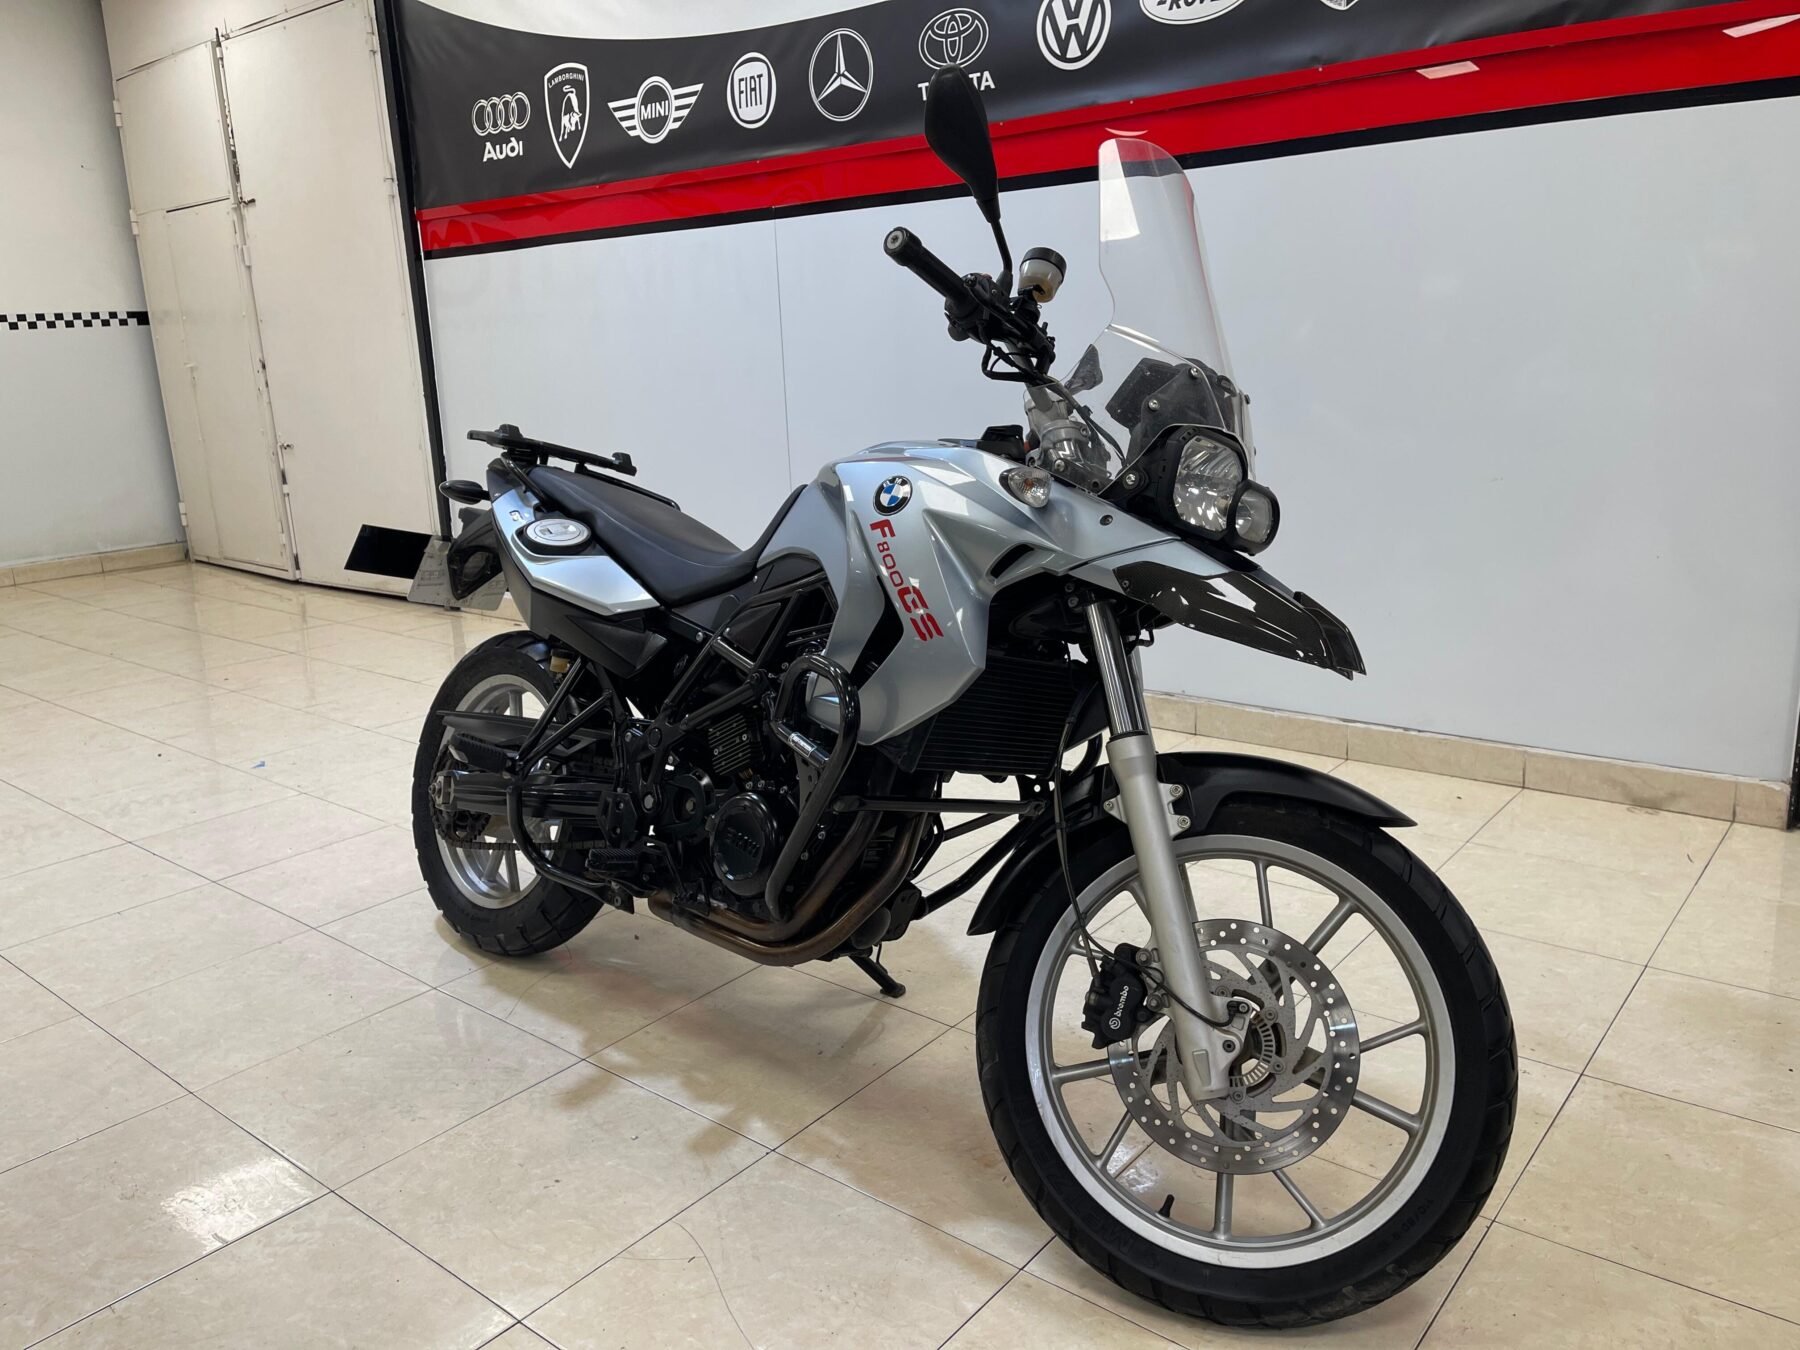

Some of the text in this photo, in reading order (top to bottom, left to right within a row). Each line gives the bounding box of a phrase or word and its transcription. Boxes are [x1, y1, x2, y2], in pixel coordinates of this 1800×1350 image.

[548, 72, 585, 89] LAMBORGHINI
[738, 73, 763, 109] FIAT
[917, 70, 996, 102] TTA
[640, 100, 669, 121] MINI
[483, 137, 523, 162] Audi
[1114, 985, 1130, 1017] brembo
